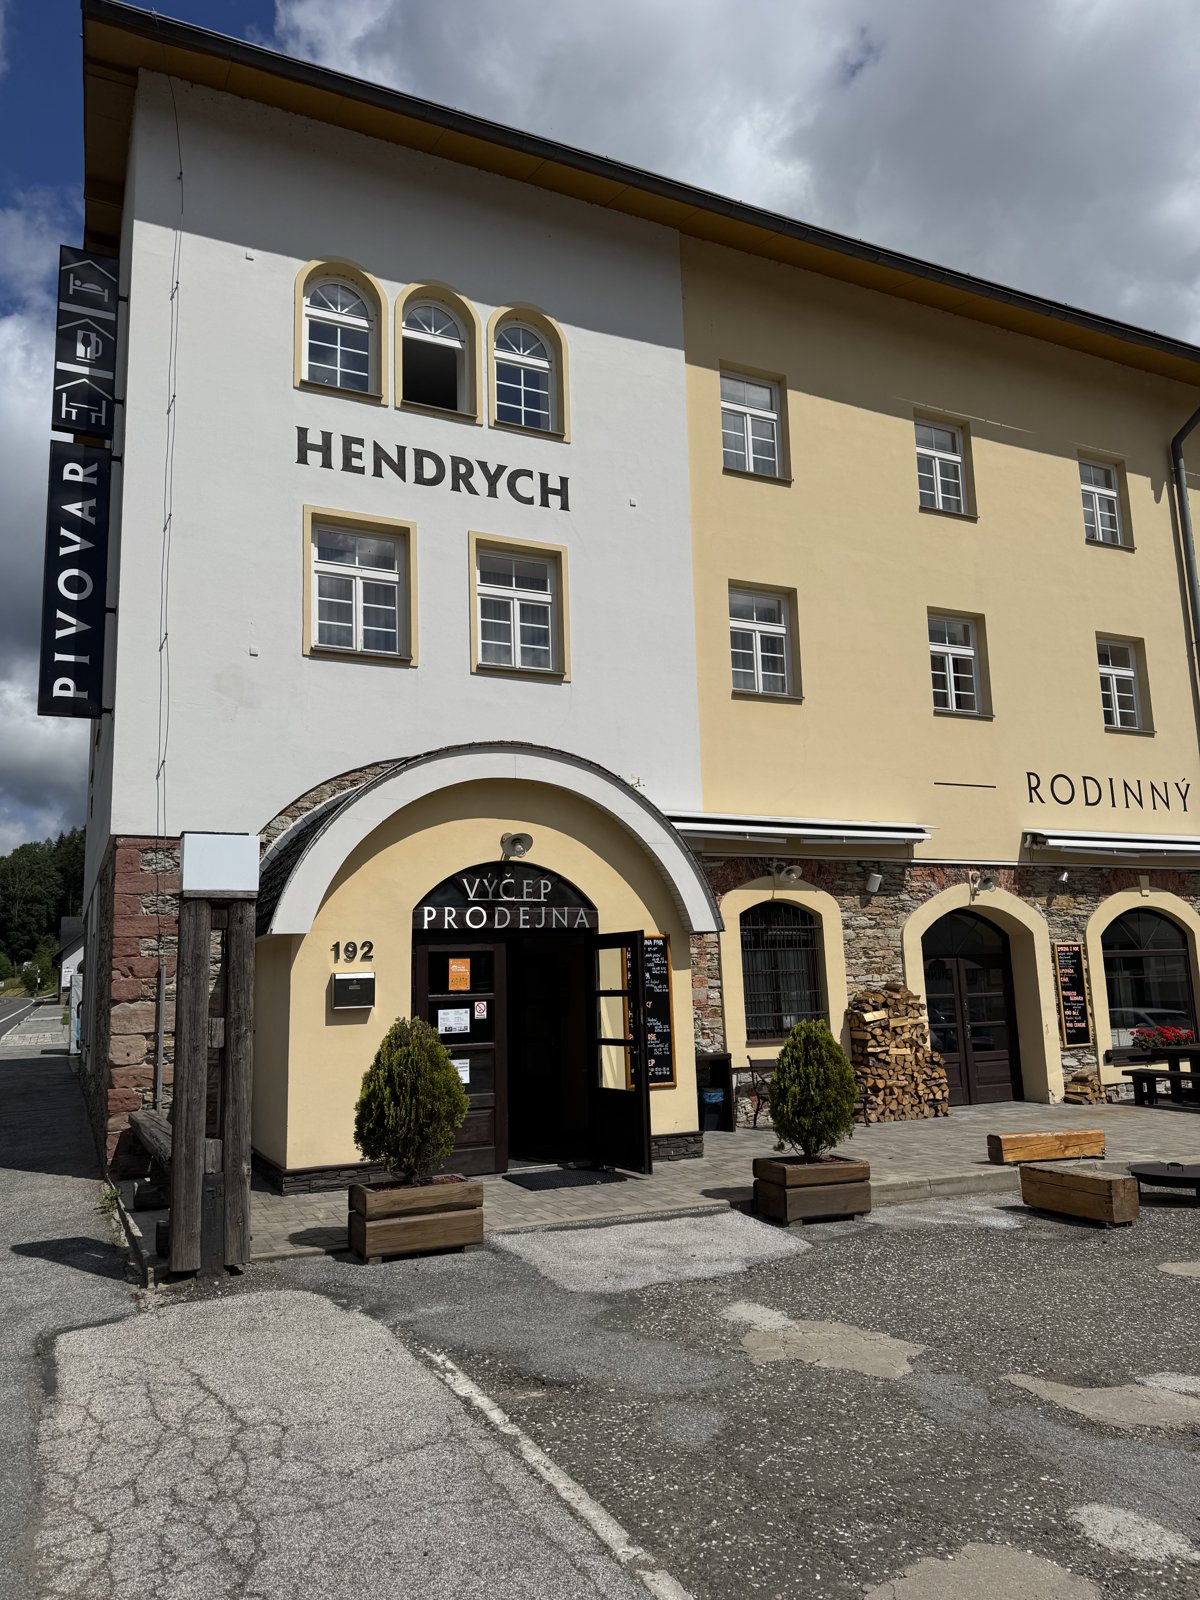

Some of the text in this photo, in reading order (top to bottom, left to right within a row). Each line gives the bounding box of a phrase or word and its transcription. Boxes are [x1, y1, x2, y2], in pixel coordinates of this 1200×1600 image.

[295, 426, 571, 512] HENDRYCH
[52, 460, 99, 700] PIVOVAR
[1025, 771, 1191, 812] RODINNÝ
[461, 872, 552, 901] VÝČEP
[423, 906, 590, 929] PRODEJNA
[330, 940, 374, 963] 192
